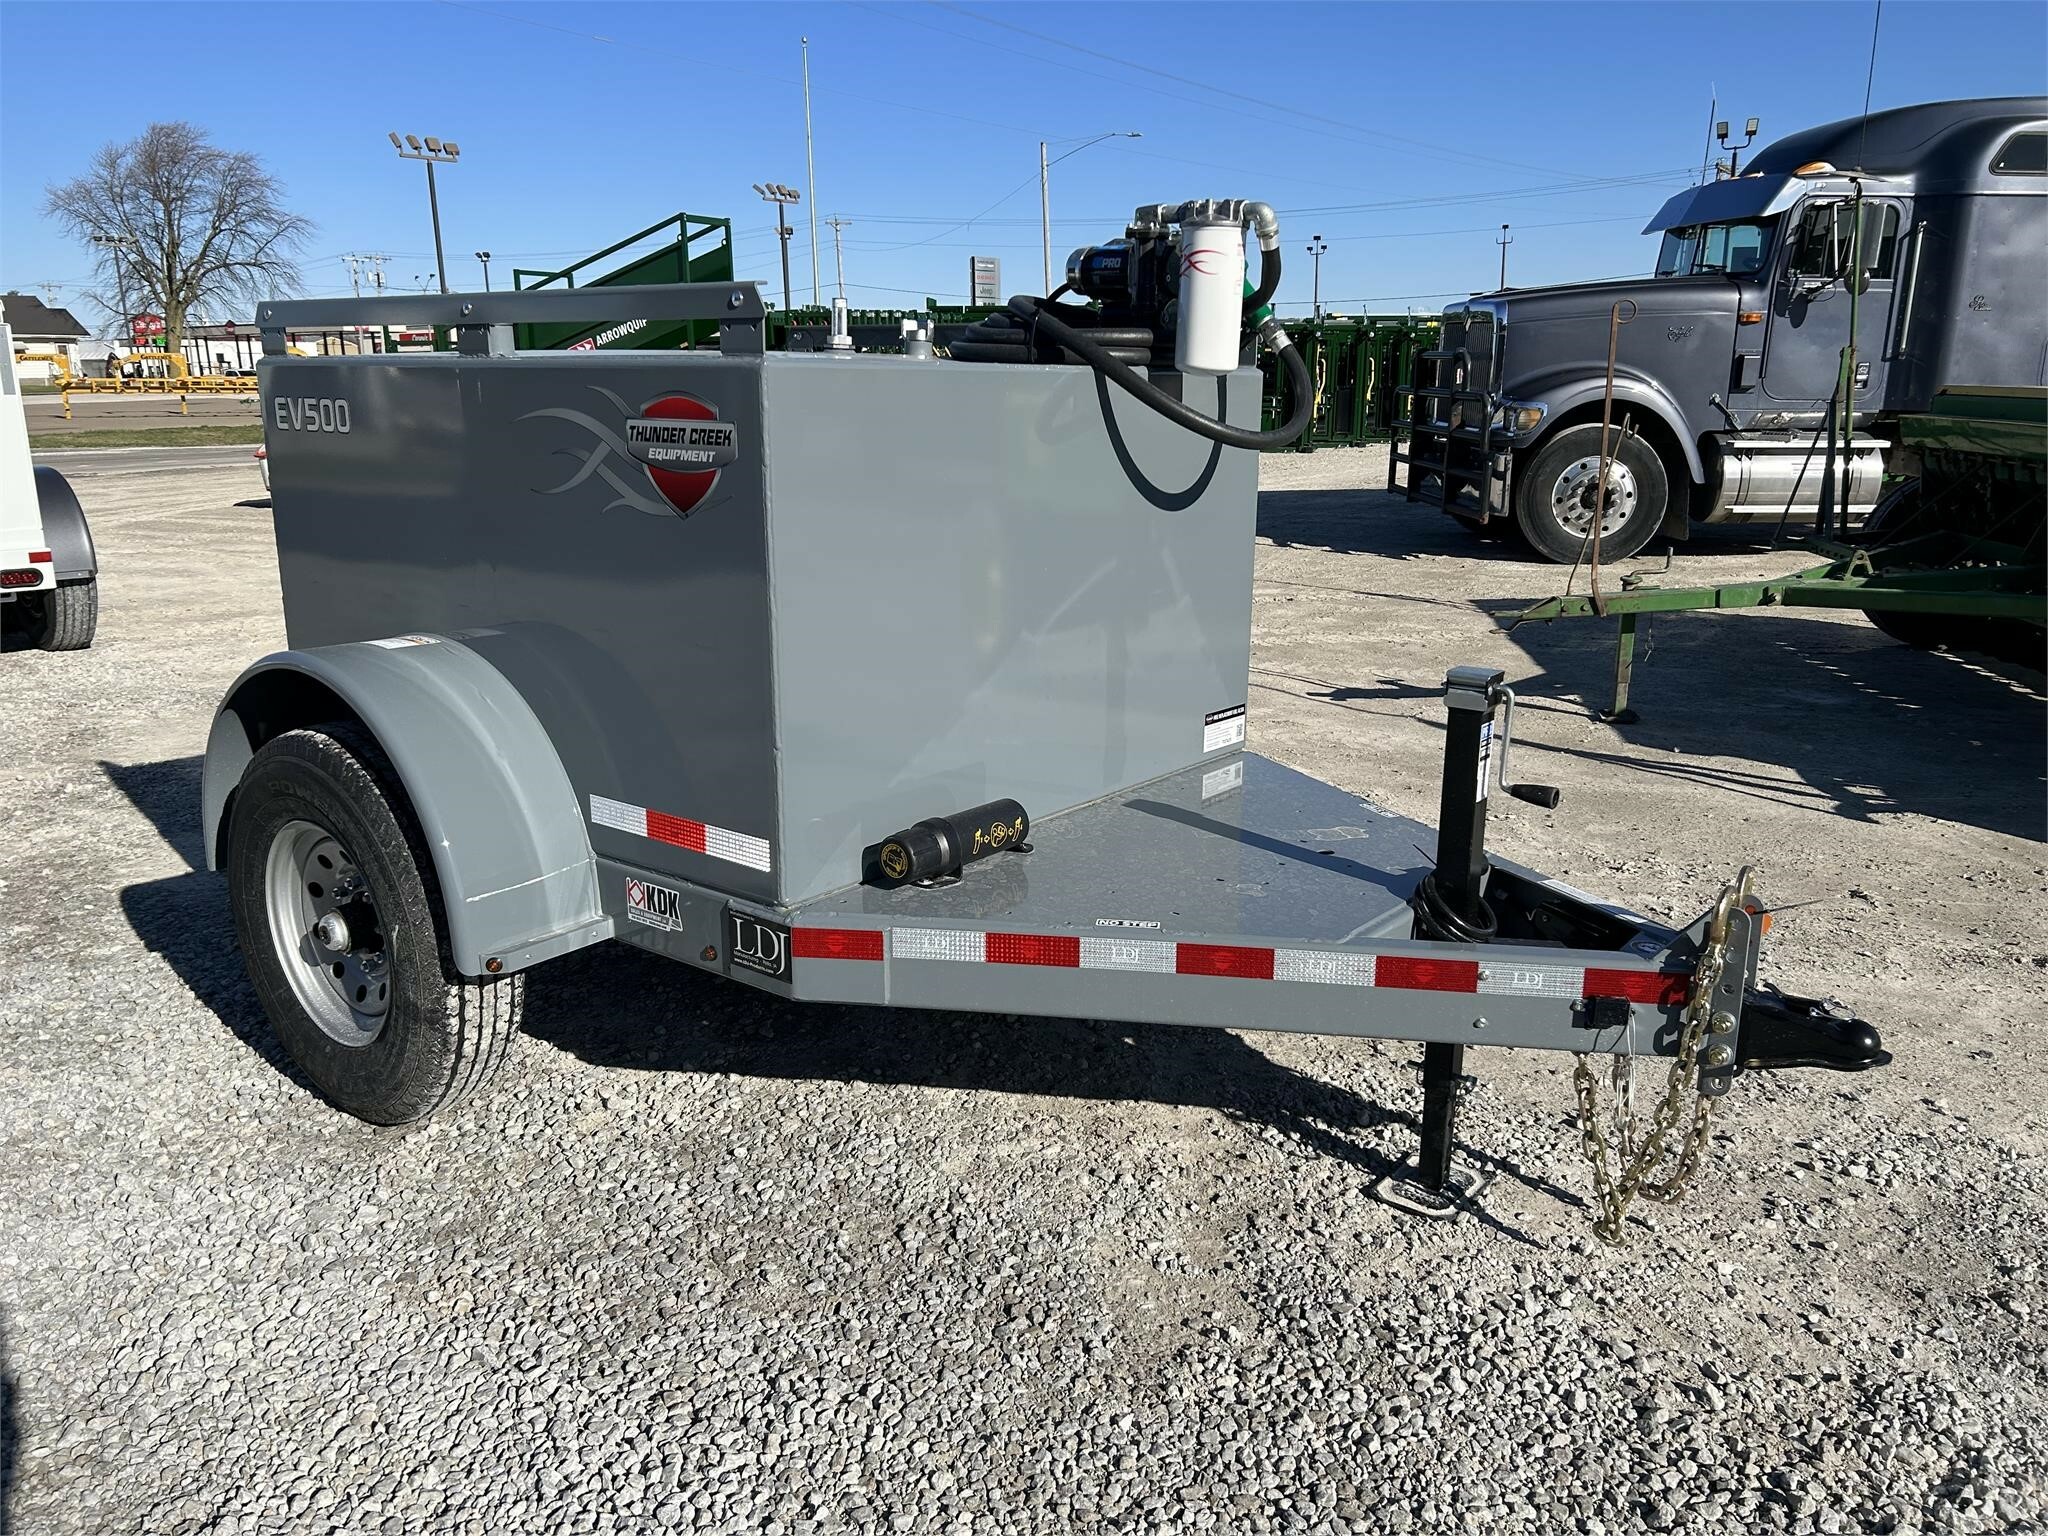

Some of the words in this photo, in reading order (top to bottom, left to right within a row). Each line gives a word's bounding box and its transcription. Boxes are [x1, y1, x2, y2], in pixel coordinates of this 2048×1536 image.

[274, 396, 350, 434] EV500
[629, 425, 686, 444] THUNDER
[688, 428, 733, 447] CREEK
[648, 448, 716, 463] EQUIPMENT
[645, 883, 680, 921] KDK
[1098, 919, 1119, 927] NO
[1122, 920, 1159, 929] STEP
[733, 917, 789, 976] LDJ
[1513, 971, 1544, 988] LDJ
